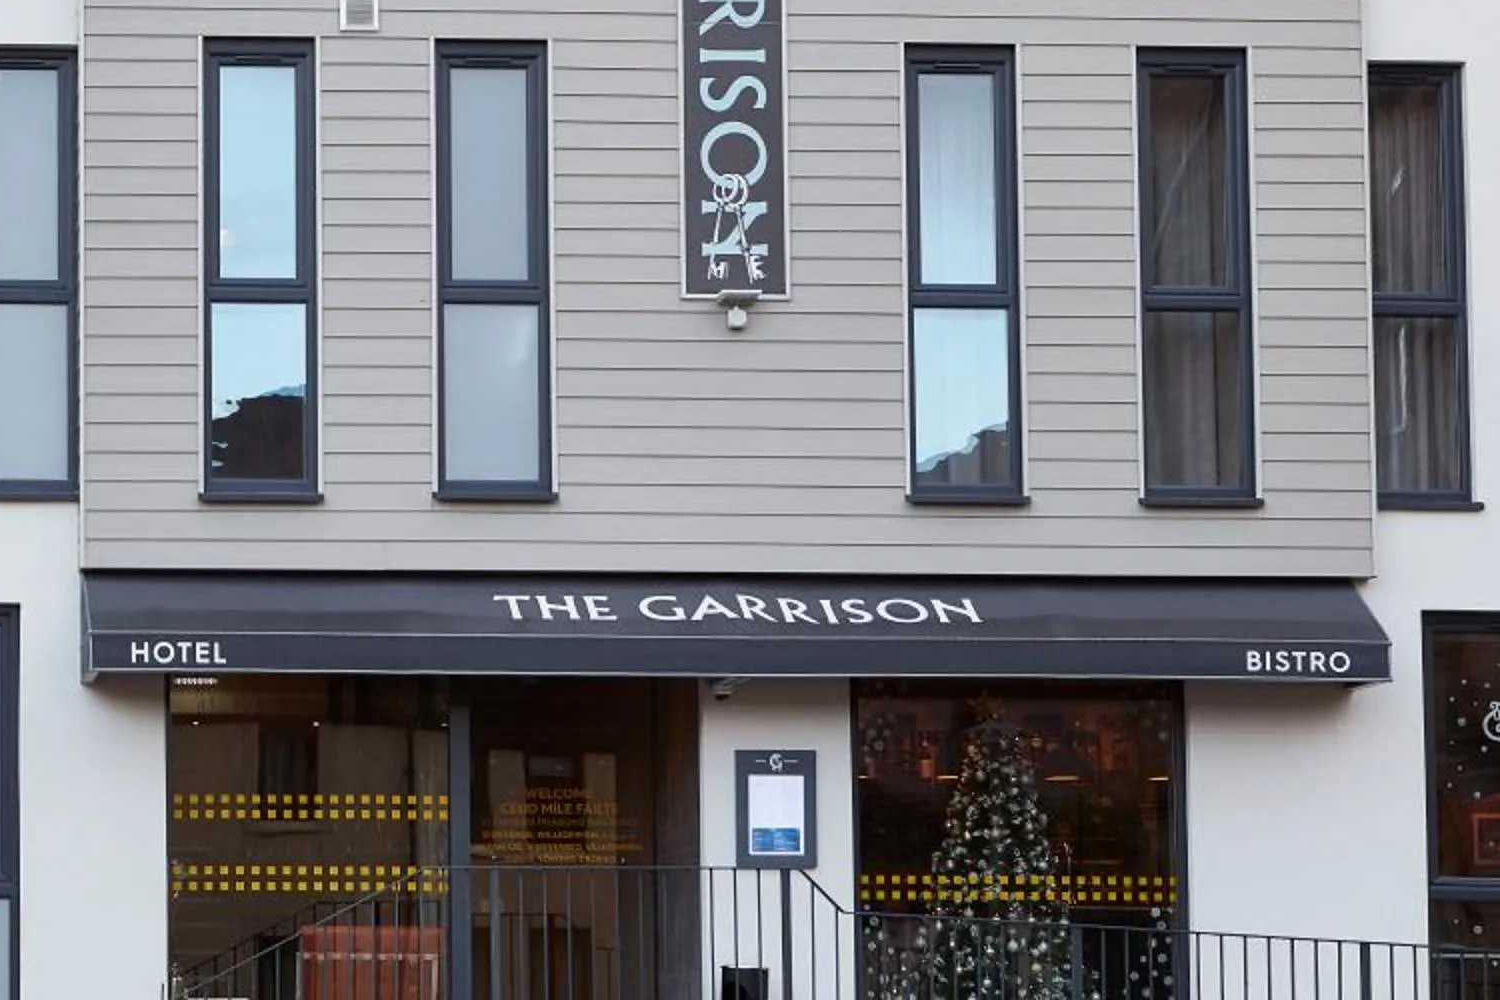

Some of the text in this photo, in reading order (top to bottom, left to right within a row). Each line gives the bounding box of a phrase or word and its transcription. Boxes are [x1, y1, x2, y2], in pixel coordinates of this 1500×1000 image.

[492, 593, 983, 625] THE GARRISON
[131, 641, 227, 665] HOTEL
[1246, 650, 1351, 673] BISTRO
